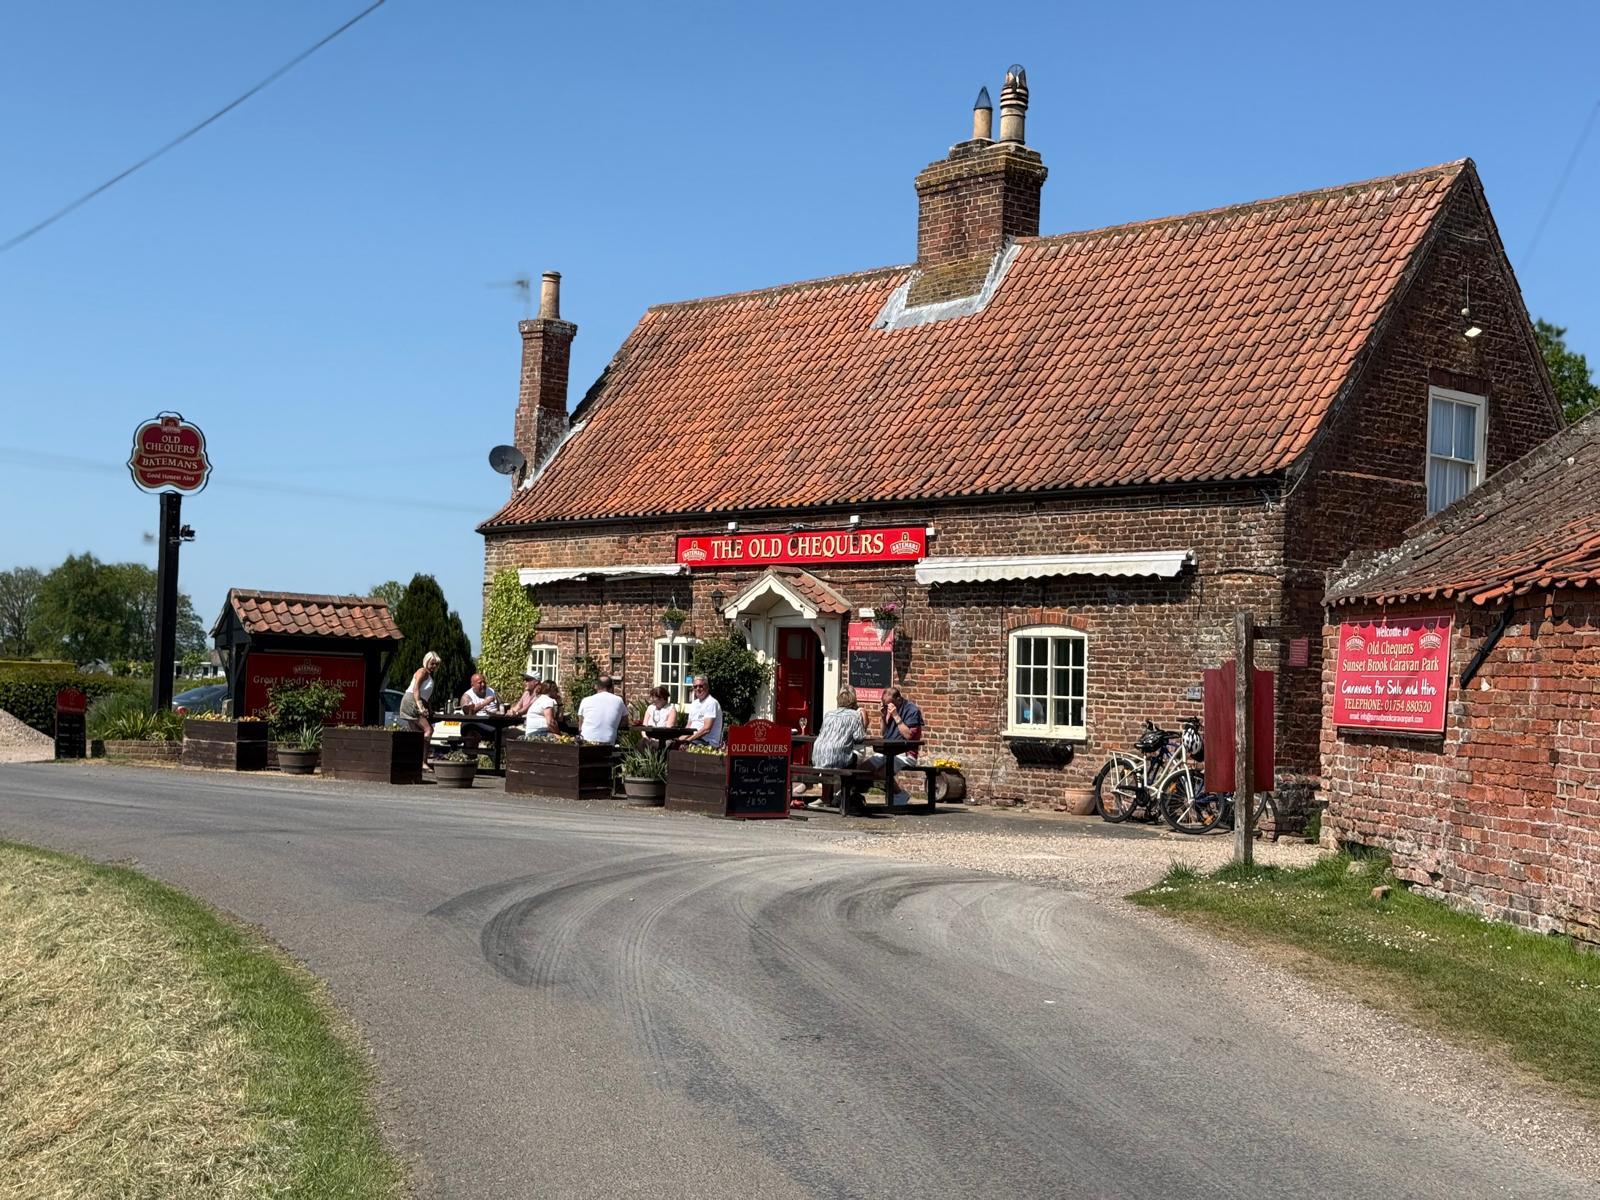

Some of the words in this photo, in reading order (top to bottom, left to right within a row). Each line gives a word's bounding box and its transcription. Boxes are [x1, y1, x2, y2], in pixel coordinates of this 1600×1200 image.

[162, 435, 181, 444] OLD
[145, 442, 196, 455] CHEQUERS
[142, 457, 198, 470] BATEMANS
[711, 539, 744, 559] THE
[748, 537, 782, 558] OLD
[787, 532, 885, 556] CHEQUERS
[1375, 626, 1402, 638] Welcome
[1367, 642, 1380, 655] Old
[1380, 640, 1414, 658] Chequers
[1342, 658, 1366, 672] Sunset
[1367, 658, 1388, 672] Brook
[1389, 658, 1420, 672] Caravan
[1421, 655, 1439, 671] Park
[1341, 679, 1372, 696] Caravans
[1375, 679, 1386, 695] for
[1386, 679, 1404, 696] Sale
[1405, 680, 1419, 696] and
[1420, 678, 1437, 696] Hire
[1344, 698, 1383, 711] TELEPHONE:
[1384, 699, 1404, 712] 01754
[335, 711, 358, 720] SITE
[731, 744, 747, 752] OLD
[748, 744, 788, 753] CHEQUERS
